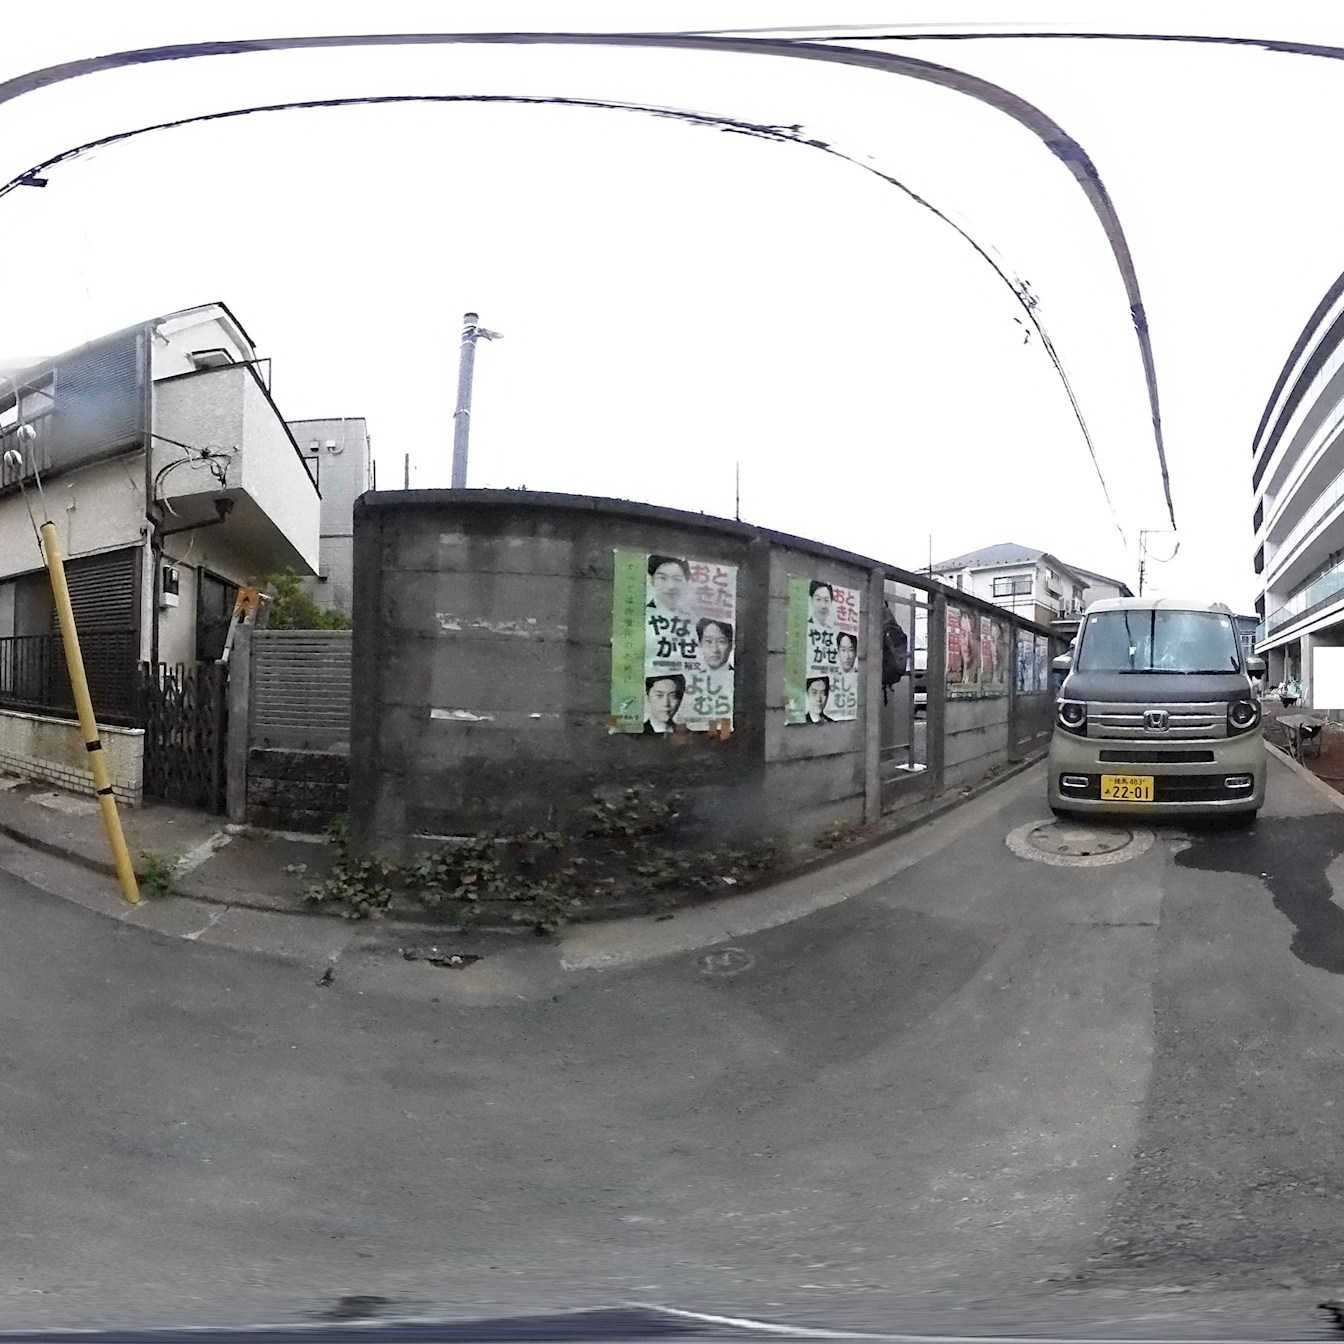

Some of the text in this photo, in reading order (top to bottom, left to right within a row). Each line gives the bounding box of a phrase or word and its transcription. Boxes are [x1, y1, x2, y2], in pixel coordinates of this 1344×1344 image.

[688, 564, 729, 588] おと
[833, 588, 855, 607] おと
[836, 605, 858, 624] きた
[648, 615, 691, 637] やな
[808, 628, 834, 647] やな
[656, 636, 698, 659] がせ
[813, 646, 838, 664] がせ
[686, 673, 723, 696] よし
[829, 676, 850, 693] よし
[693, 695, 732, 716] むら
[834, 692, 856, 709] むら
[1112, 786, 1149, 799] 22-01
